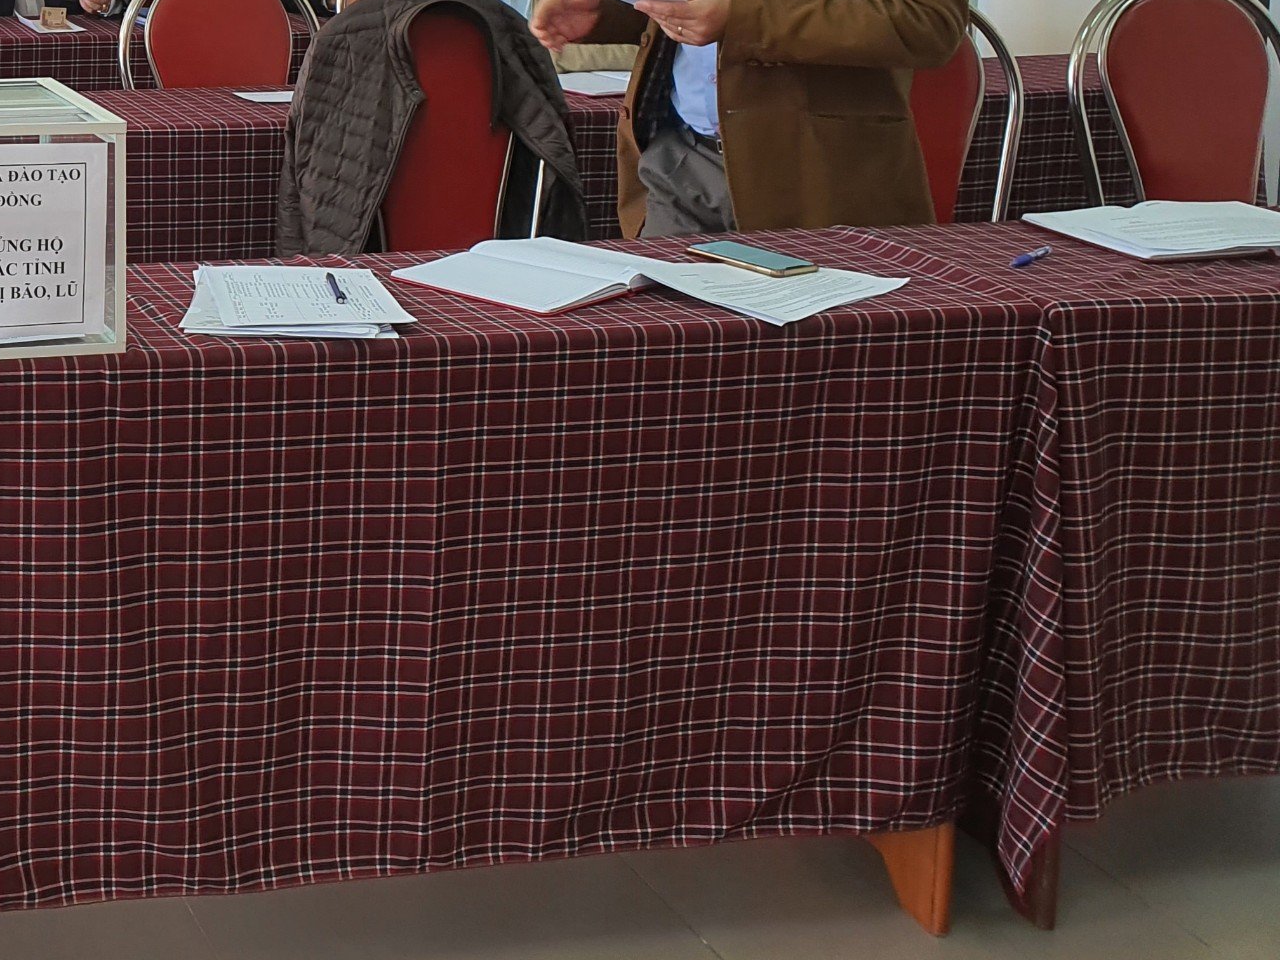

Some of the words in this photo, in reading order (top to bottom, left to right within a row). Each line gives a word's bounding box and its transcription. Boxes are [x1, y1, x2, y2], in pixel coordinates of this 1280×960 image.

[8, 166, 42, 182] ĐÀO
[47, 168, 81, 184] TẠO
[37, 235, 64, 254] HỘ
[23, 257, 65, 275] TỈNH
[10, 282, 51, 300] BÃO,
[56, 280, 78, 297] LŨ
